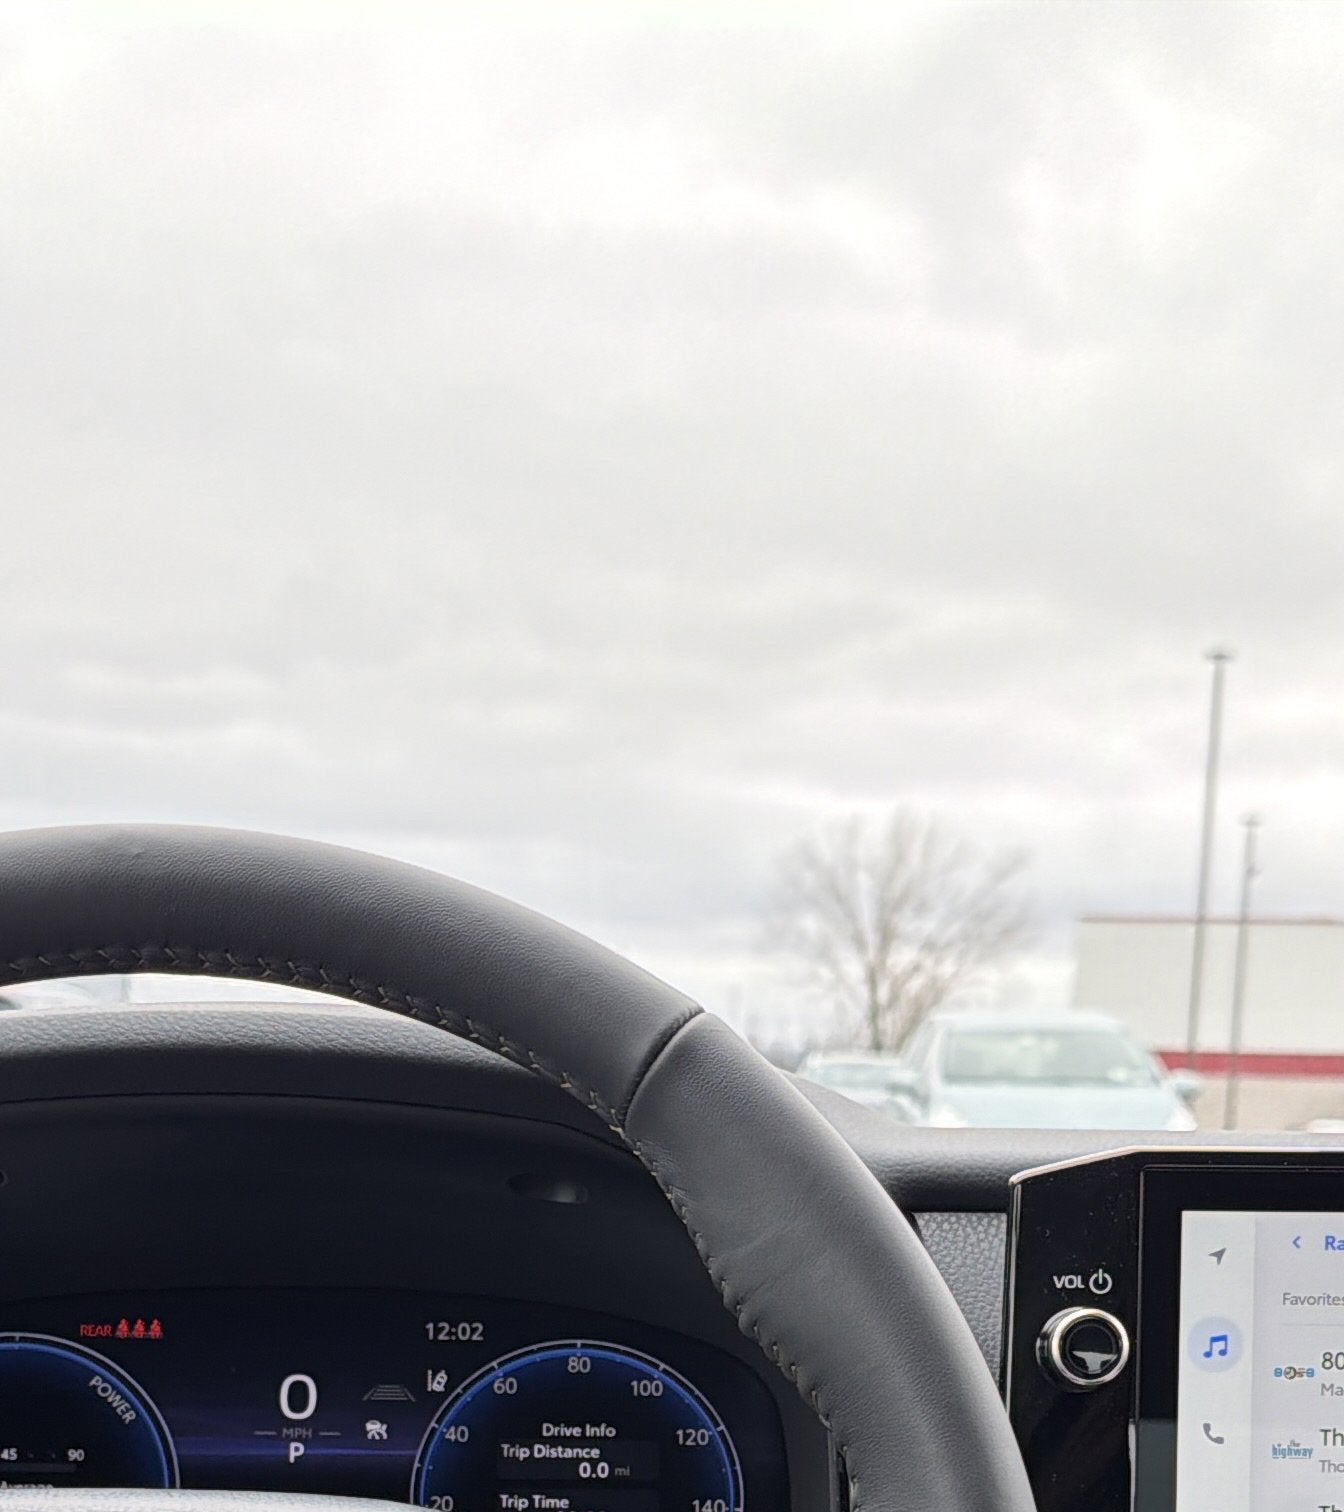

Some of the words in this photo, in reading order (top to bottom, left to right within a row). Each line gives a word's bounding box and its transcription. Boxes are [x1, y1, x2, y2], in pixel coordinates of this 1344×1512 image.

[1053, 1274, 1085, 1289] VOL
[80, 1324, 113, 1337] REAR
[425, 1322, 484, 1341] 12:02
[567, 1356, 591, 1373] 80
[493, 1378, 518, 1395] 60
[630, 1380, 663, 1397] 100
[88, 1375, 137, 1425] POWER
[278, 1373, 318, 1420] 0
[282, 1428, 312, 1439] MPH
[445, 1426, 469, 1442] 40
[542, 1423, 581, 1438] Drive
[586, 1423, 616, 1438] Info
[676, 1428, 709, 1445] 120
[0, 1448, 18, 1460] 45
[67, 1449, 85, 1461] 90
[288, 1443, 305, 1462] P
[501, 1444, 529, 1460] Trip
[534, 1444, 600, 1459] Distance
[578, 1462, 609, 1479] 0.0
[615, 1465, 630, 1476] mi
[430, 1495, 454, 1512] 20
[500, 1495, 529, 1511] Trip
[532, 1495, 569, 1509] Time
